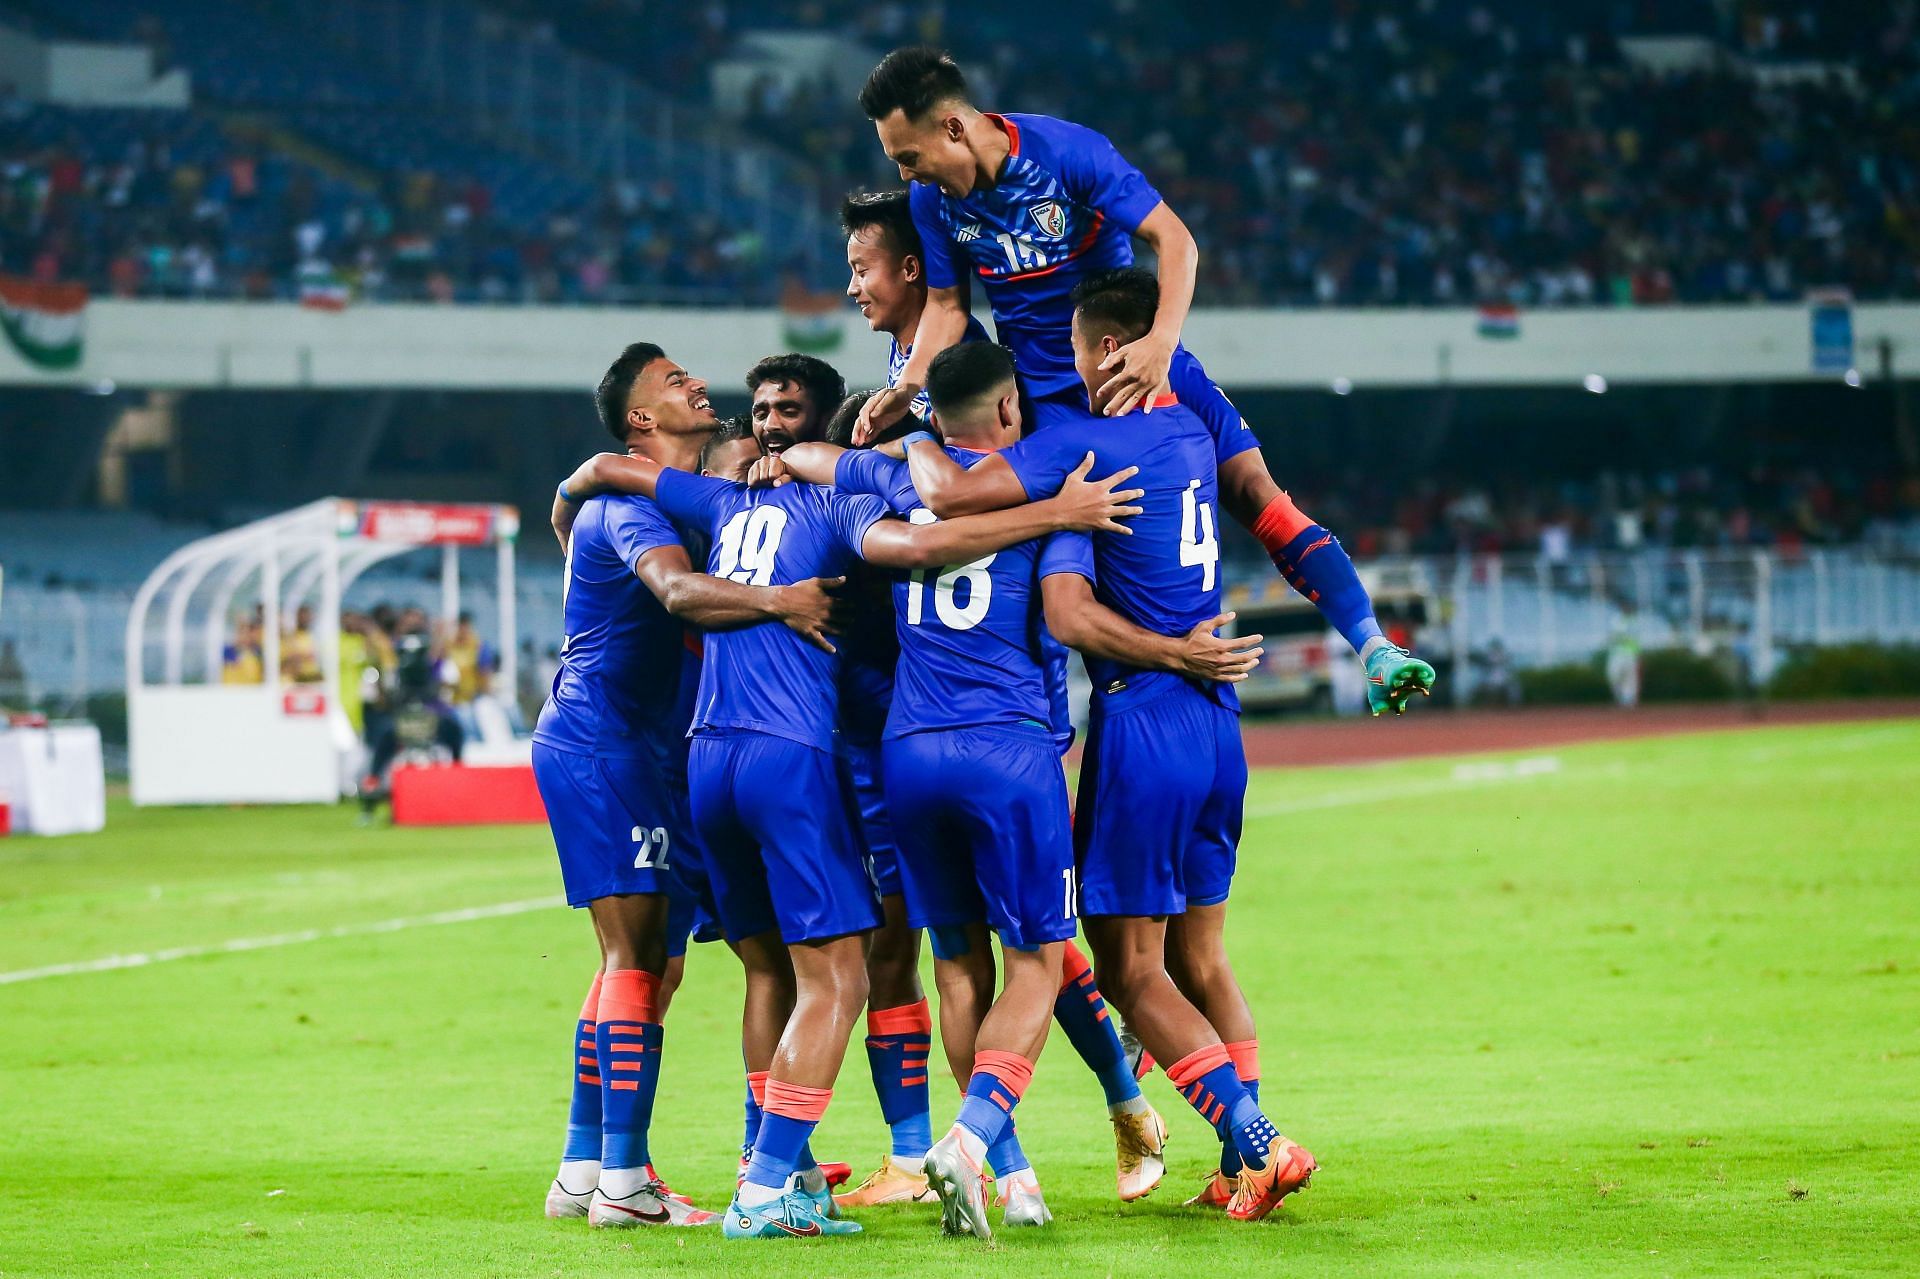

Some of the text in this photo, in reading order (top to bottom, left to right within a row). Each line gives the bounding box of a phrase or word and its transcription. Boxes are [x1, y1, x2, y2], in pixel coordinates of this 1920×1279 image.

[997, 233, 1047, 272] 15
[715, 505, 788, 586] 19
[1180, 479, 1218, 592] 4
[632, 826, 669, 870] 22
[1063, 865, 1077, 919] 1
